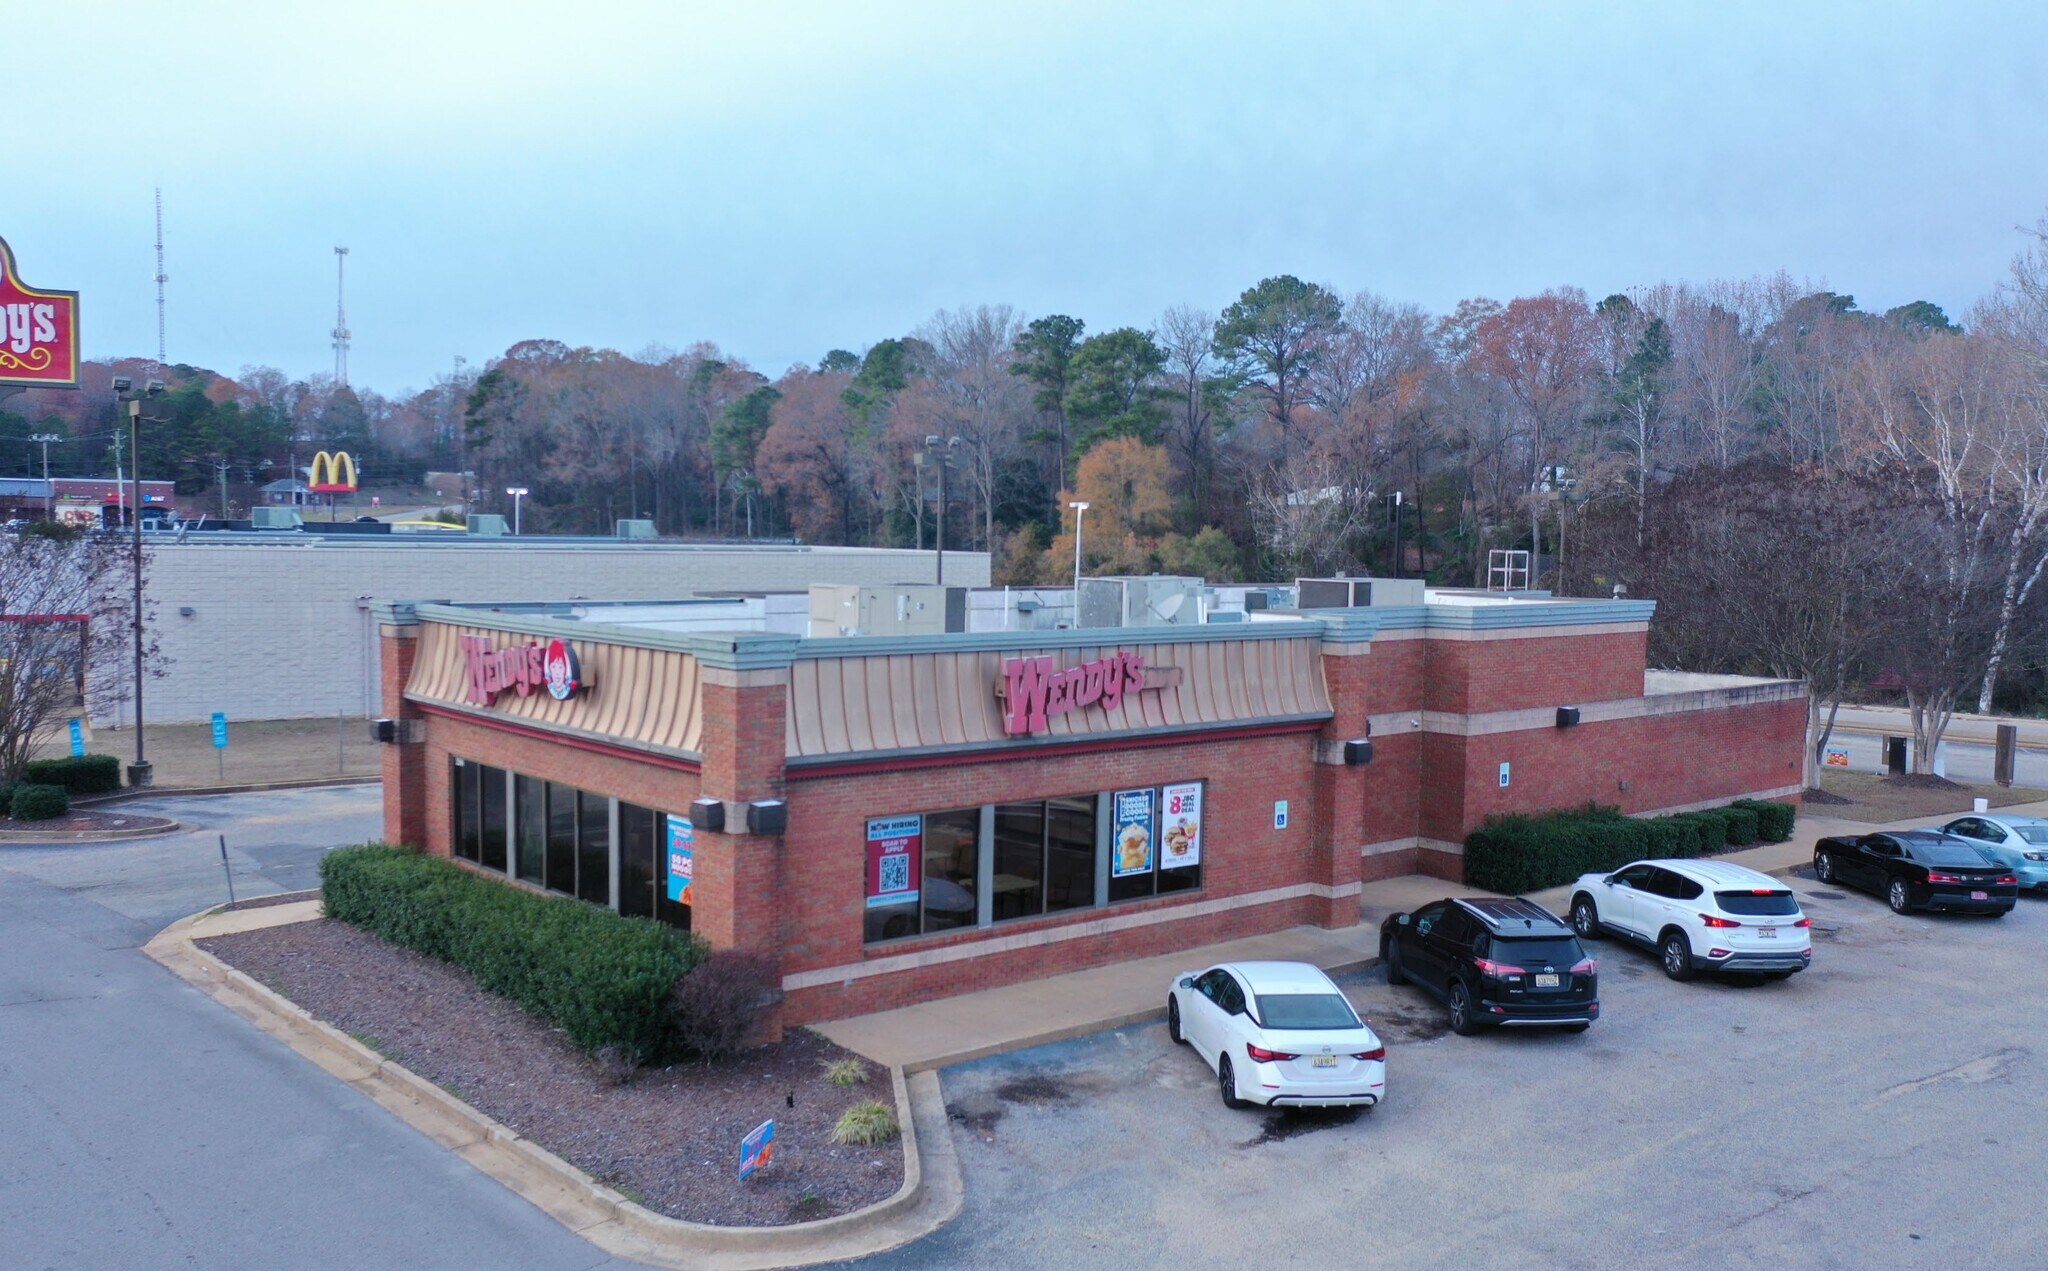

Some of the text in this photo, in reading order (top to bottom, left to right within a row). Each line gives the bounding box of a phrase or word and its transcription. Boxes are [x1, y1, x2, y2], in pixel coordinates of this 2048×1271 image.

[0, 302, 56, 353] y's
[870, 820, 918, 831] NOW HIRING
